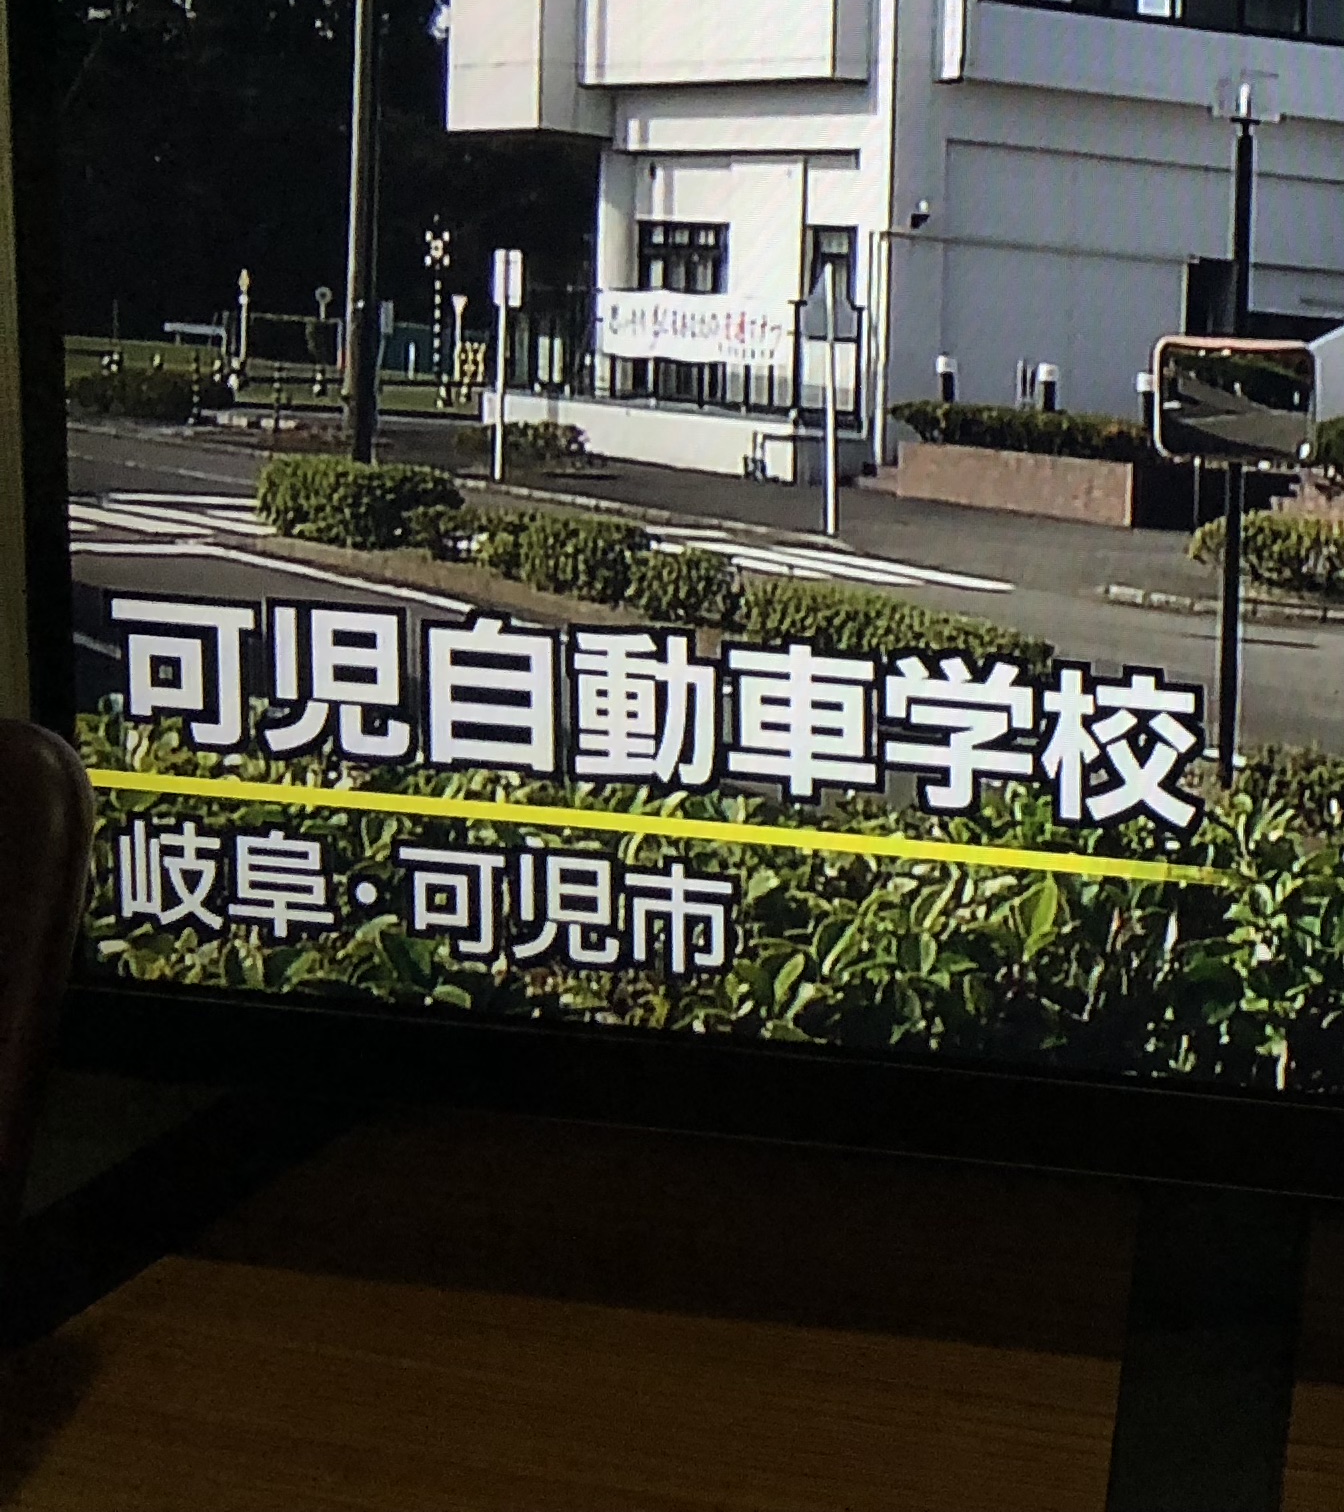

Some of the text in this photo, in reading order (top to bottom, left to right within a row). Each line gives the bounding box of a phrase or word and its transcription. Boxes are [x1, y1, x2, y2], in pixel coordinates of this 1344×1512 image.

[110, 598, 1199, 830] 可児自動車学校
[118, 822, 735, 974] 岐阜・可児市
